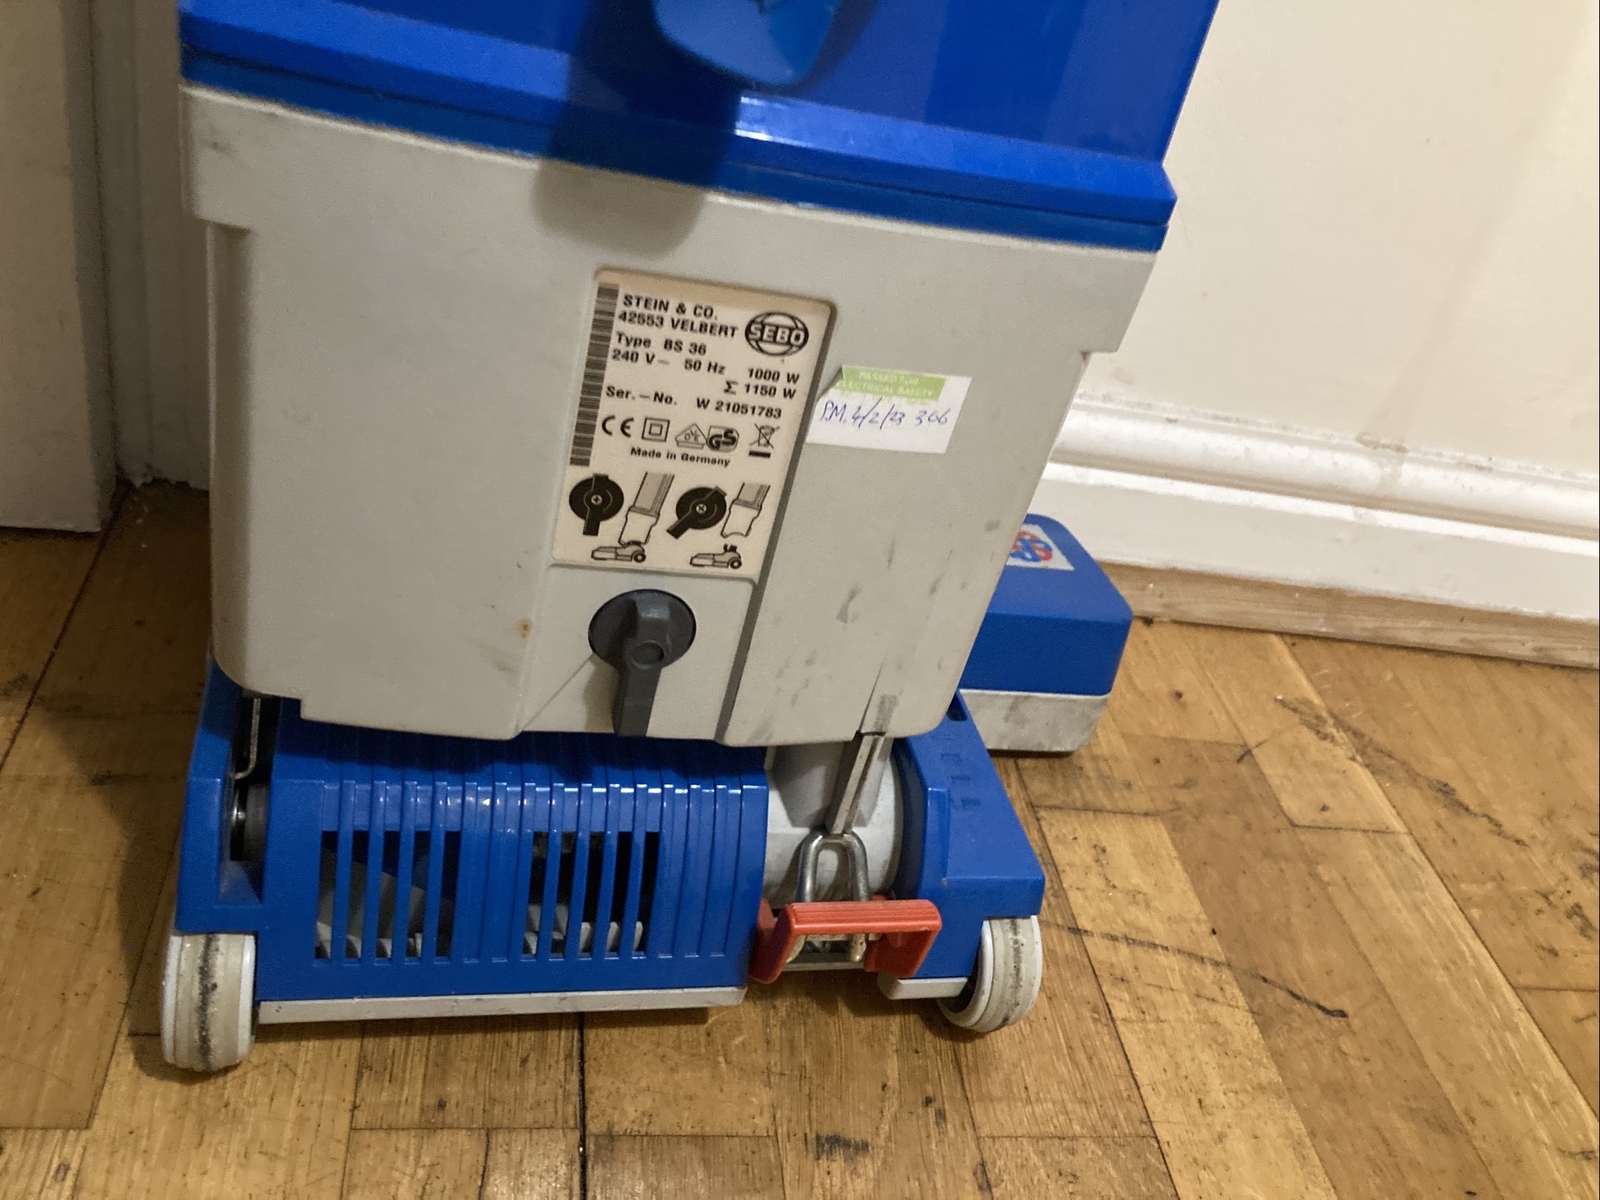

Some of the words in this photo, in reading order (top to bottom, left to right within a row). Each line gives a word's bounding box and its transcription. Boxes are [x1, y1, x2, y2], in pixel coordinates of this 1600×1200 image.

[623, 294, 669, 313] STEIN
[676, 302, 687, 315] &
[693, 305, 718, 321] CO.
[618, 310, 664, 328] 42553
[671, 318, 738, 338] VELBERT
[748, 323, 806, 346] SEBO
[616, 331, 652, 349] Type
[664, 338, 684, 353] BS
[689, 342, 707, 356] 36
[612, 348, 639, 363] 240
[684, 359, 702, 372] 50
[707, 362, 726, 375] Hz
[749, 368, 780, 383] 1000
[787, 373, 800, 384] W
[745, 383, 777, 397] 1150
[783, 388, 796, 400] W
[897, 385, 934, 397] SAFETY
[697, 397, 710, 410] W
[715, 401, 782, 419] 21051783
[631, 446, 662, 459] Made
[666, 451, 677, 460] in
[681, 453, 731, 467] Germany
